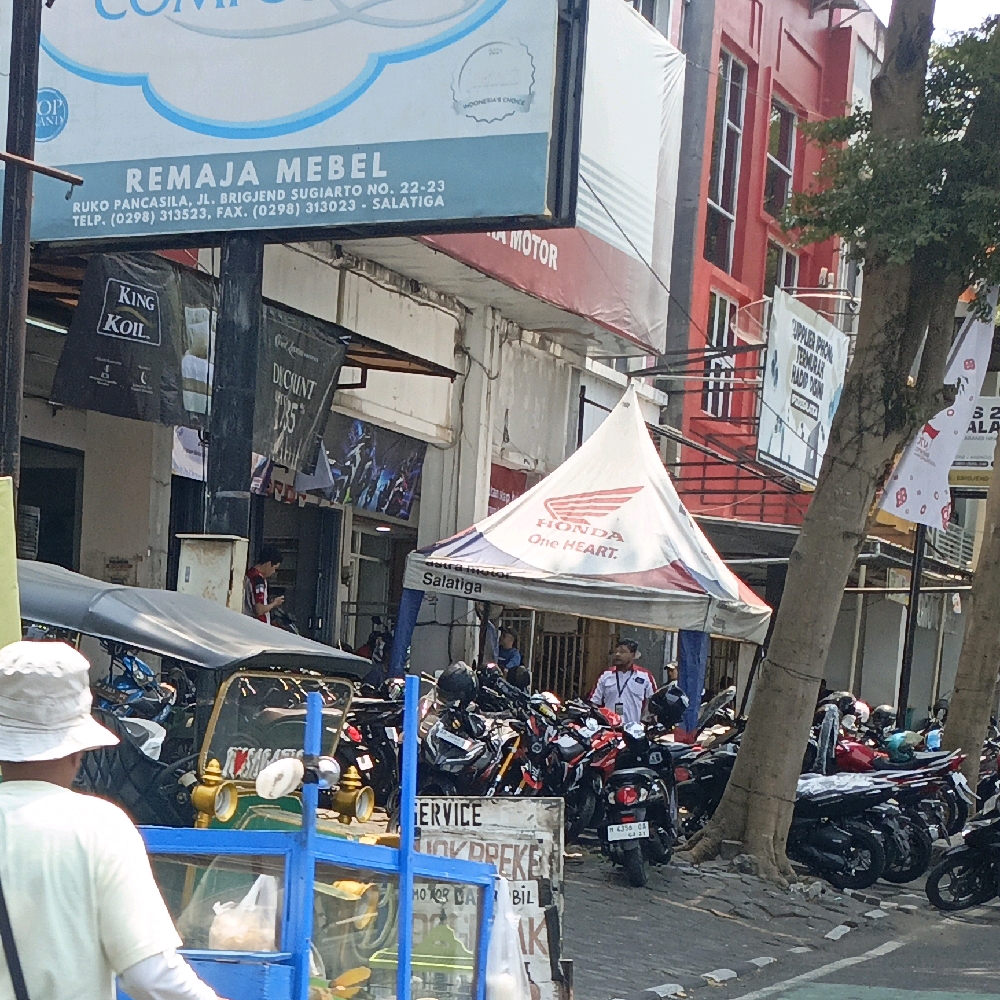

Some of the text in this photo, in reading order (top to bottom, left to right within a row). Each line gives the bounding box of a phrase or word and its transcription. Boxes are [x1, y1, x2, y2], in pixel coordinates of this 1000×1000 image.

[36, 99, 63, 116] OP
[39, 115, 64, 127] AND
[126, 152, 387, 193] REMAJA MEBEL
[73, 180, 445, 213] RUKO PANCASILA, JL. BRIGJEND SUGIARTO NO. 22-23
[72, 213, 106, 227] TELP.
[111, 210, 155, 228] (0298)
[160, 203, 212, 221] 313523,
[216, 206, 248, 220] FAX.
[252, 203, 300, 219] (0298)
[306, 199, 356, 215] 313023
[372, 195, 445, 211] SALATIGA
[510, 230, 558, 271] MOTOR
[118, 285, 155, 311] KING
[103, 313, 148, 339] KOIL
[536, 518, 625, 543] HONDA
[528, 533, 618, 560] One HEART.
[422, 571, 483, 595] Salatiga
